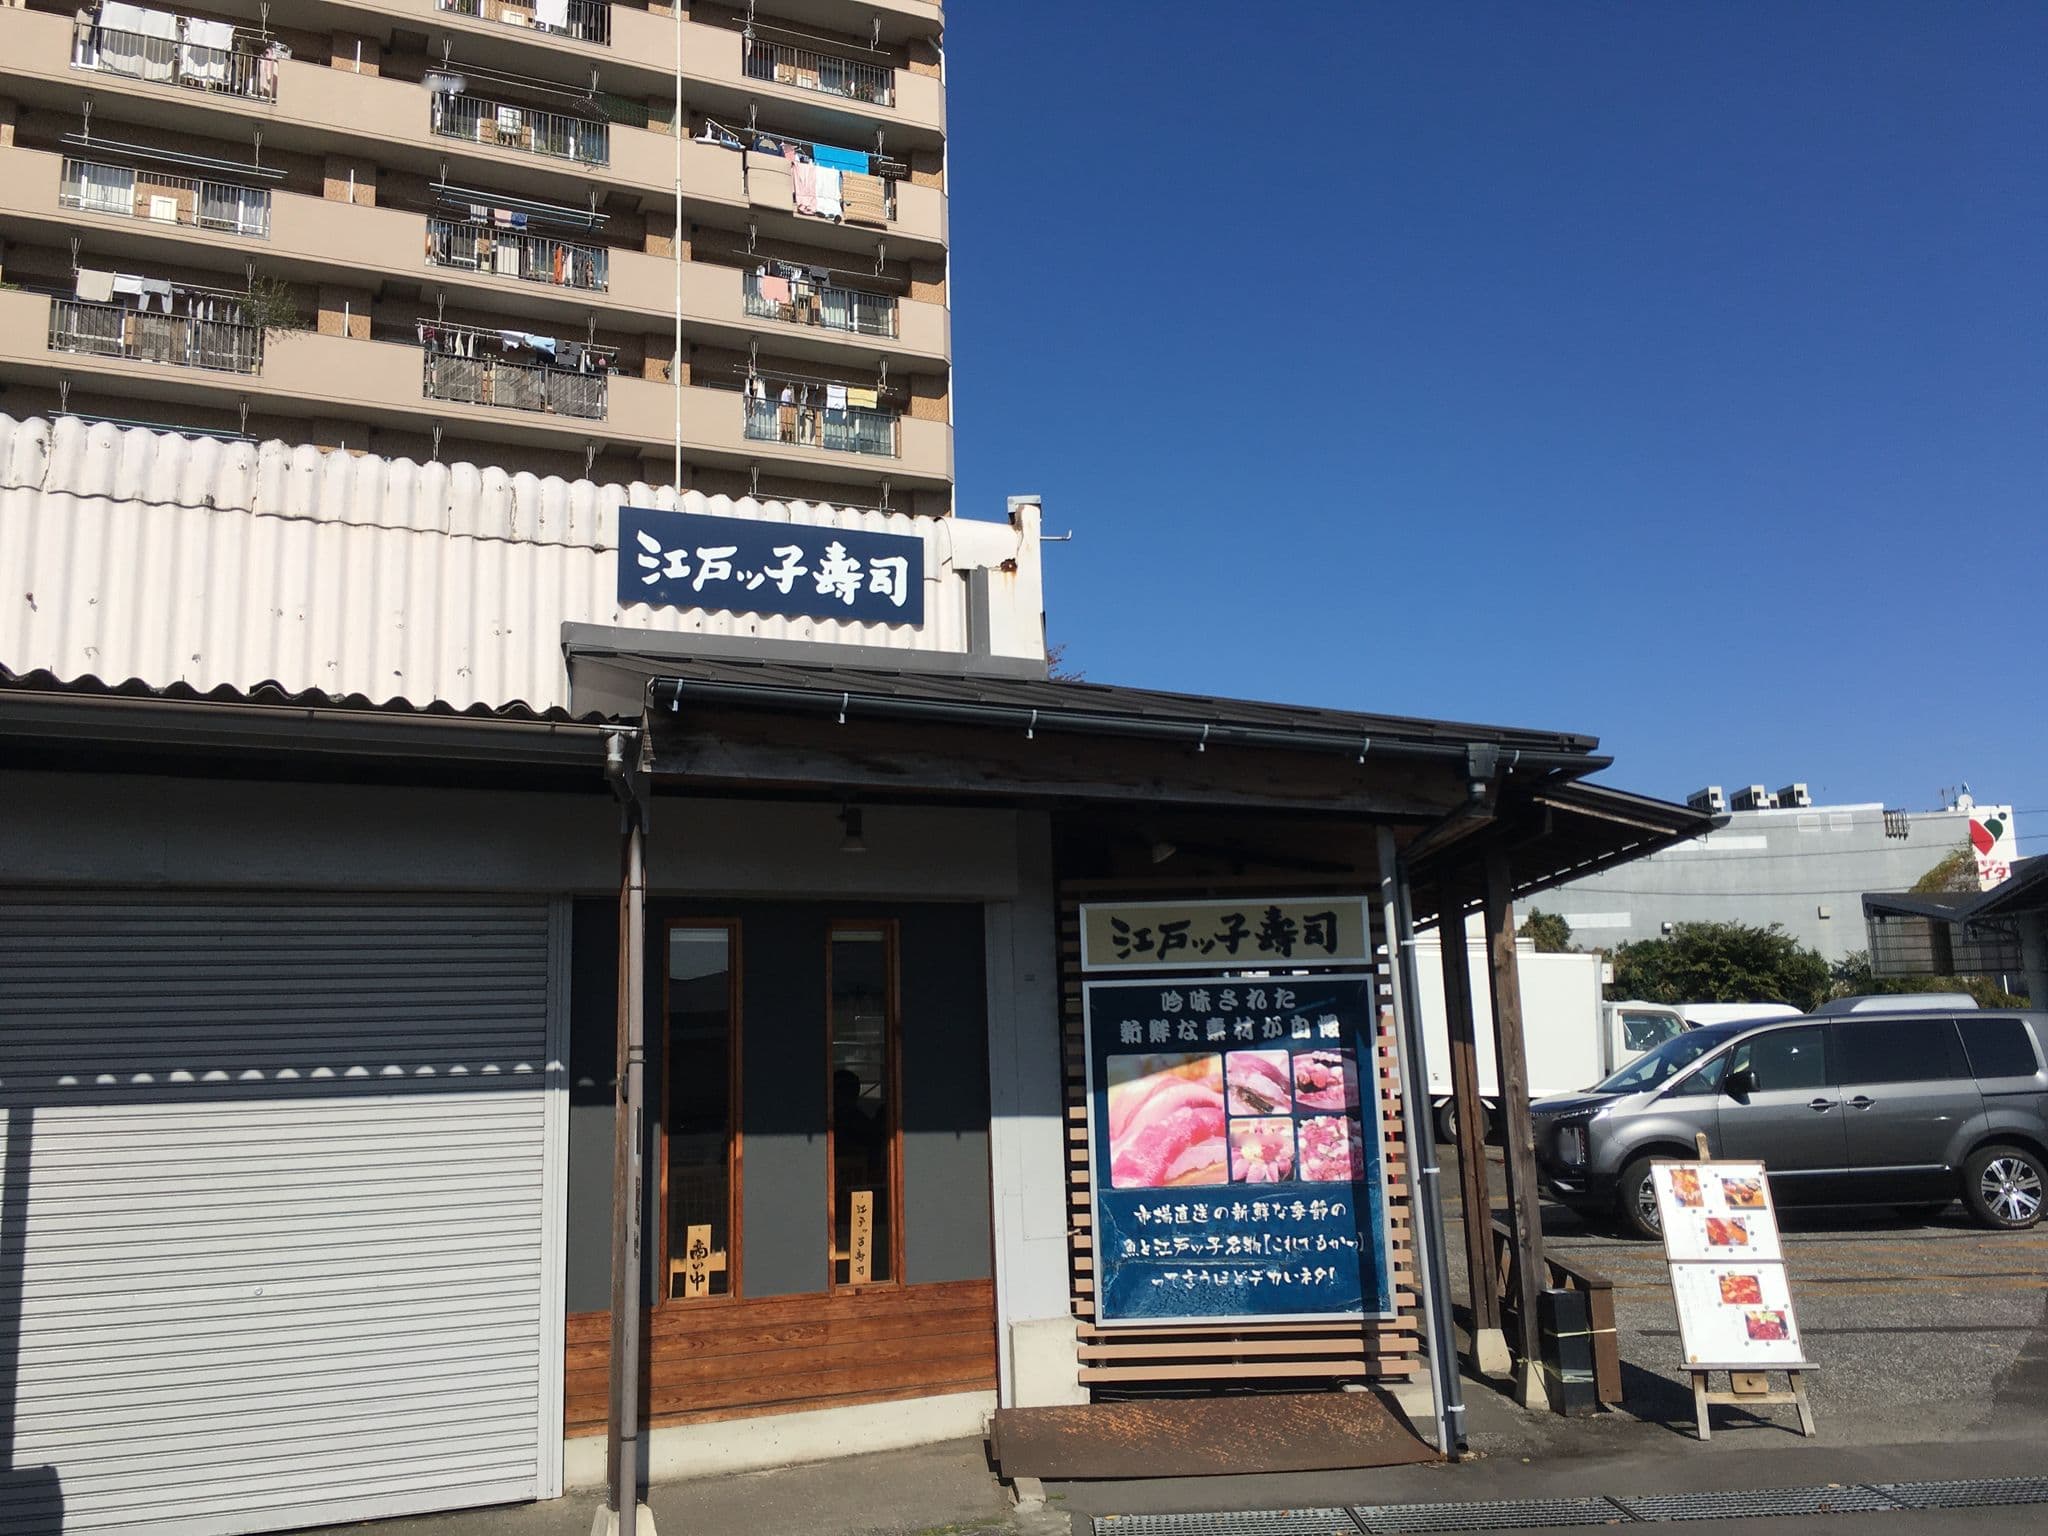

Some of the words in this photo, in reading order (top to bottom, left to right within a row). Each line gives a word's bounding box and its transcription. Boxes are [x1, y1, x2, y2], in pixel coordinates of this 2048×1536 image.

[637, 530, 908, 607] 江戸ッ子寿司
[1111, 906, 1337, 960] 江戸ッ子寿司
[1161, 988, 1297, 1012] 吟味された
[1120, 1015, 1340, 1044] 新鮮な素材が自慢
[1133, 1200, 1346, 1226] 市場直送の新鮮な季節の
